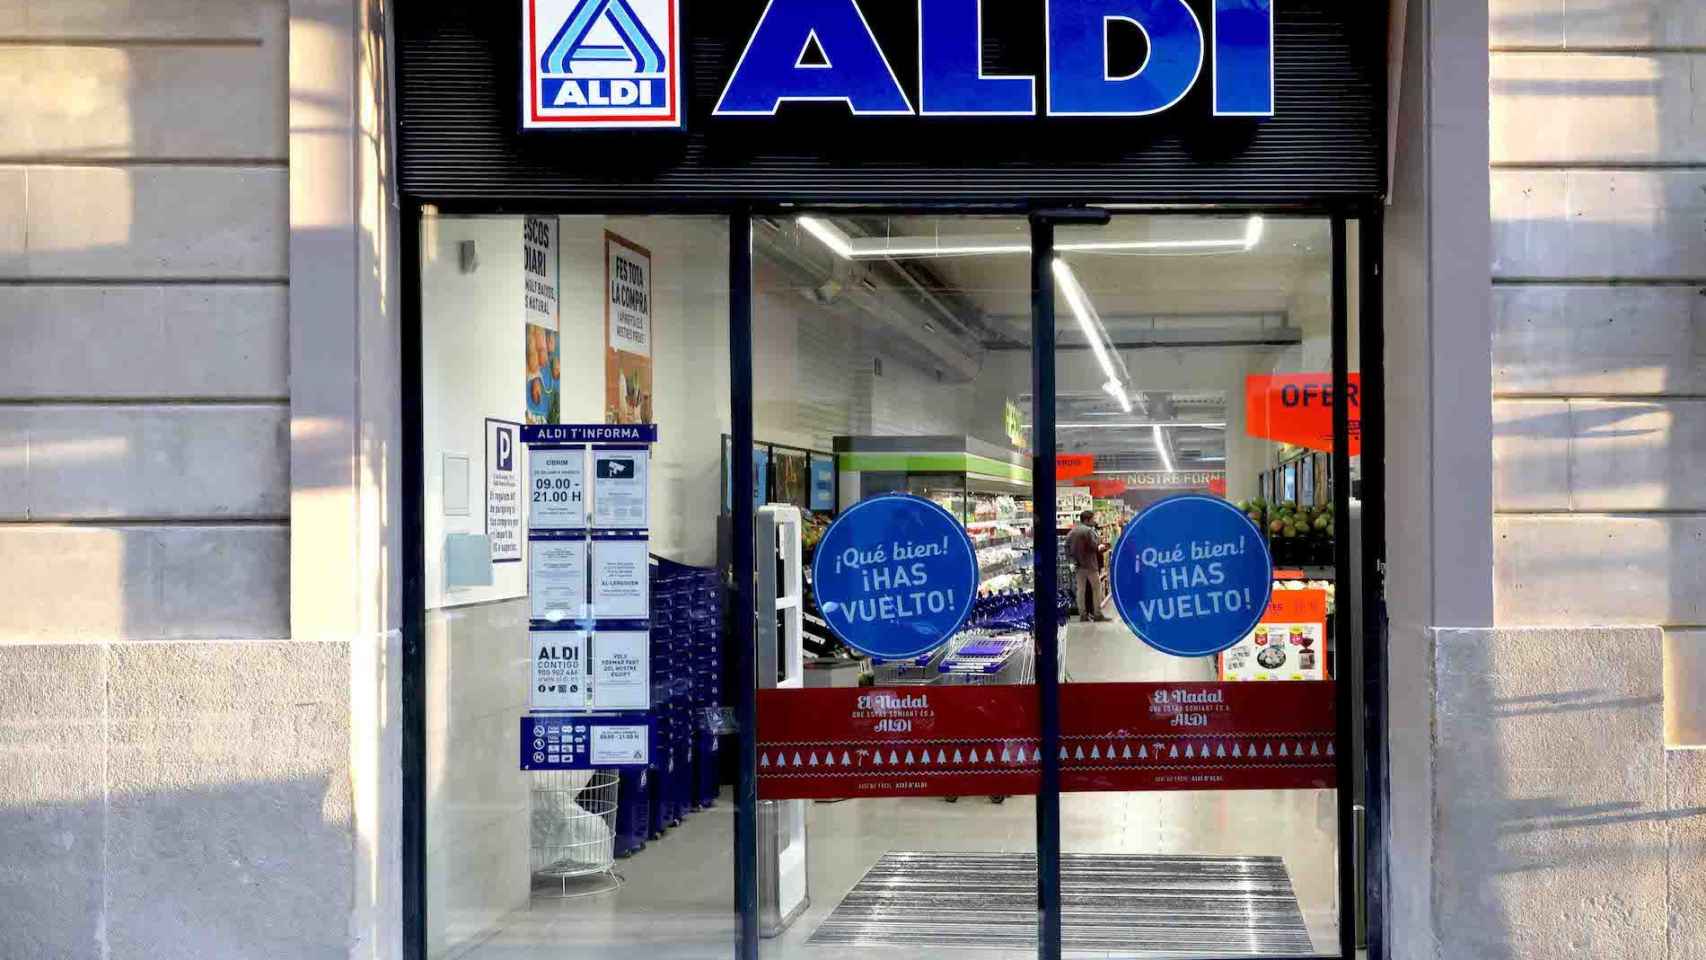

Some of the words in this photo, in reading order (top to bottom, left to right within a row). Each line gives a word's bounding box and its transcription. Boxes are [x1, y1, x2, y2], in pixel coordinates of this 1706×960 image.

[712, 0, 1275, 118] ALDI
[554, 81, 653, 106] ALDI
[616, 255, 628, 282] FES
[628, 261, 644, 288] TOTA
[611, 280, 621, 304] LA
[621, 285, 648, 315] COMPRA
[538, 428, 567, 439] ALDI
[571, 428, 640, 439] T'INFORMA
[500, 431, 511, 467] P
[536, 478, 571, 490] 09.00
[1127, 473, 1180, 485] NOSTRE
[533, 491, 568, 502] 21.00
[572, 491, 581, 502] H
[836, 545, 887, 574] ¡Qué
[893, 536, 949, 561] bien!
[1134, 545, 1188, 574] ¡Qué
[1191, 535, 1246, 562] bien!
[863, 563, 928, 592] ¡HAS
[1159, 562, 1225, 591] ¡HAS
[838, 590, 956, 624] VUELTO!
[1138, 587, 1252, 622] VUELTO!
[538, 646, 579, 660] ALDI
[538, 661, 579, 669] CONTIGO
[874, 694, 929, 709] Nadal
[1171, 689, 1224, 703] Nadal
[874, 719, 912, 732] ALDI
[1170, 713, 1208, 726] ALDI
